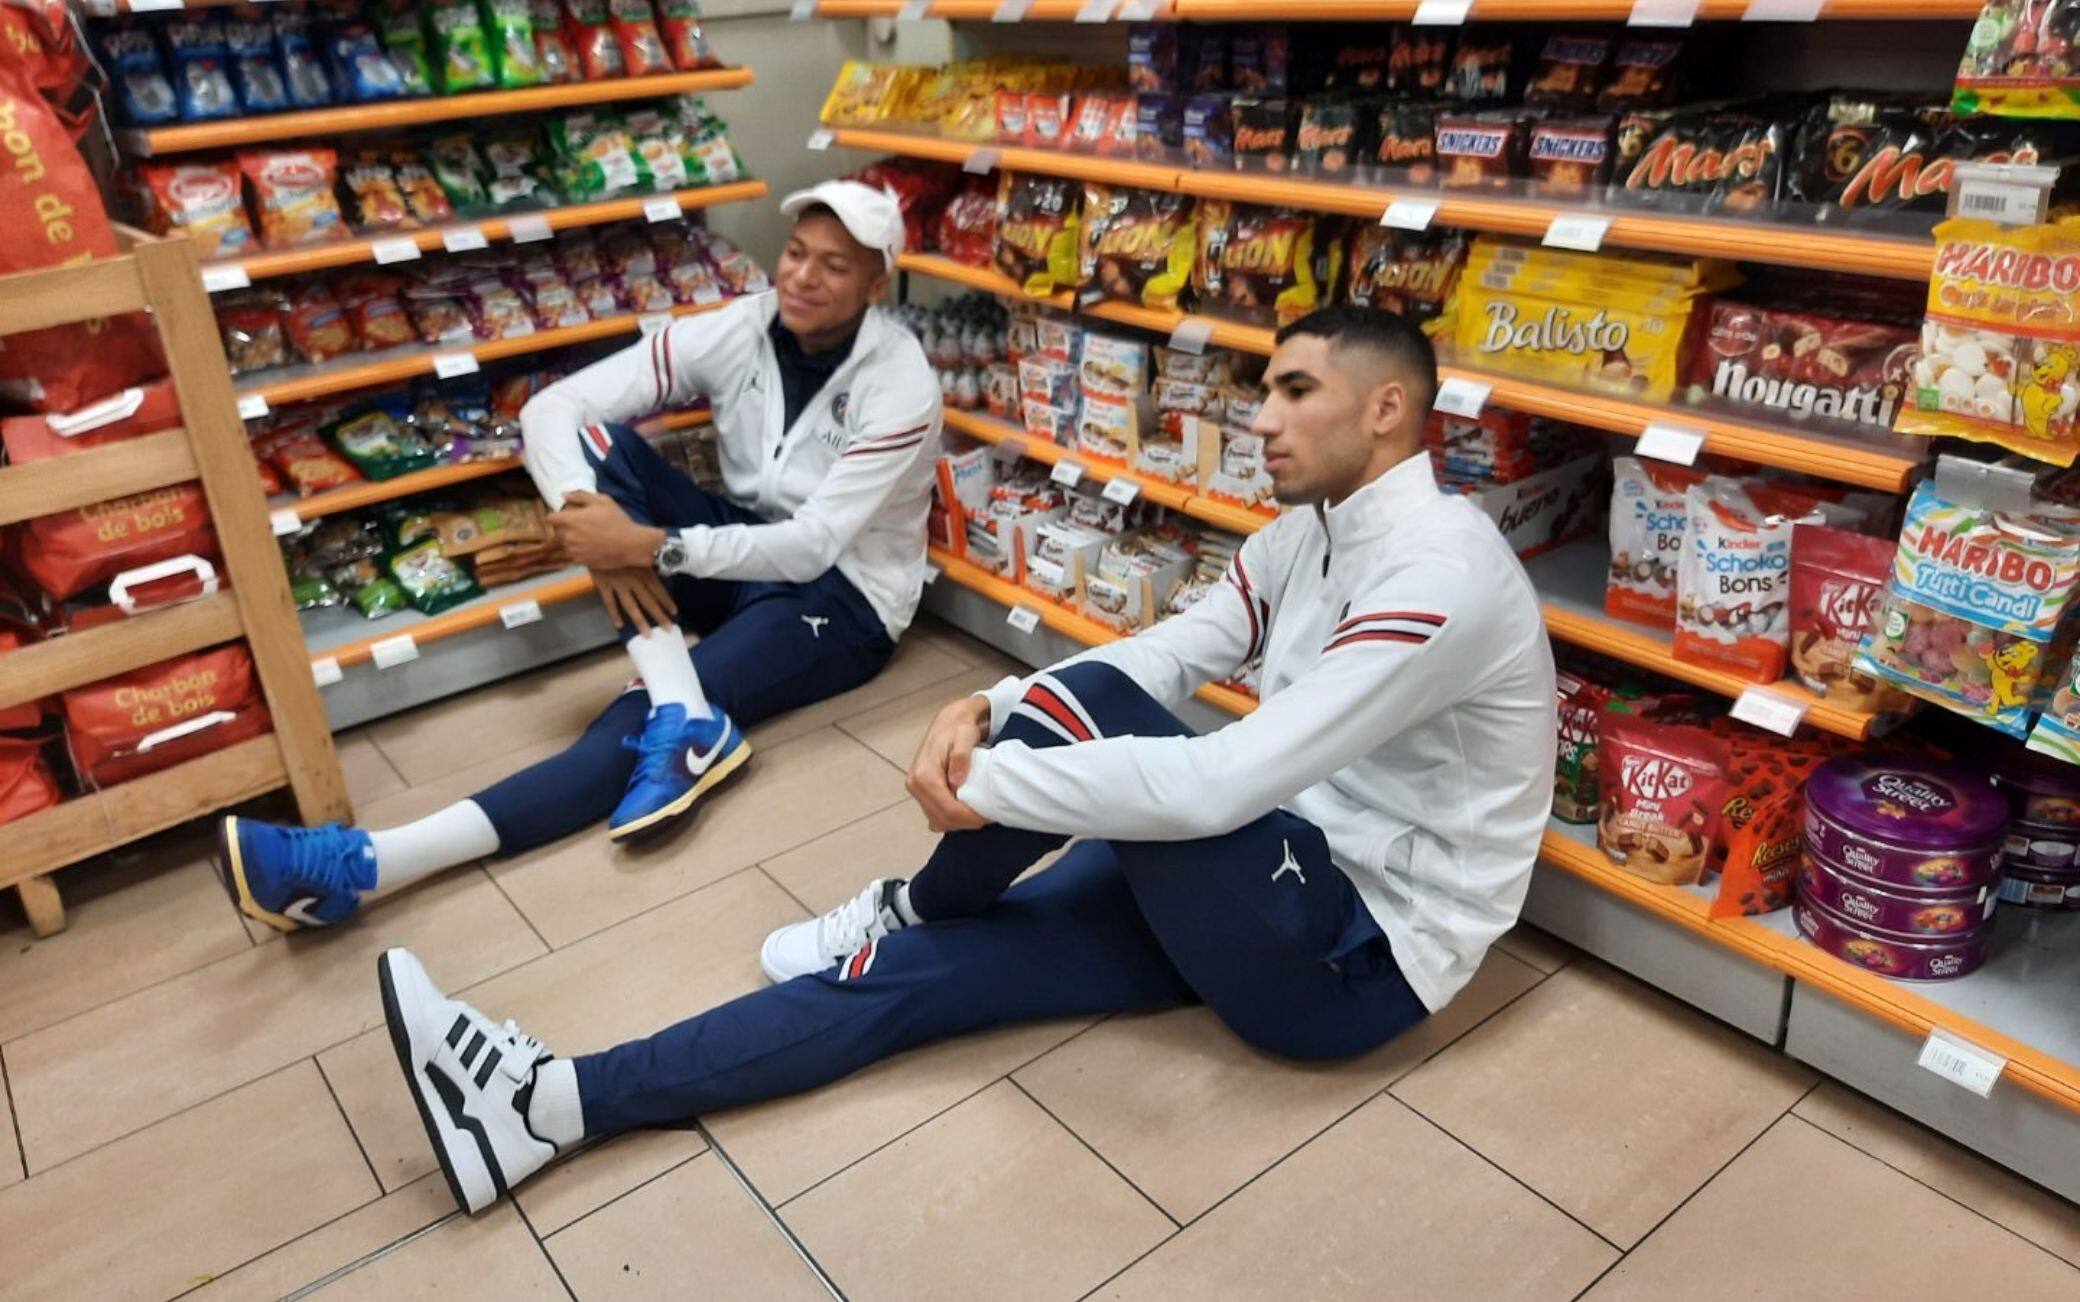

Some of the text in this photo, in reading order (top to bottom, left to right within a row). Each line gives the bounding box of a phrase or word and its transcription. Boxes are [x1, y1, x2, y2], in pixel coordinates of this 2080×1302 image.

[1440, 132, 1502, 151] SNICKERS
[1535, 136, 1608, 157] SNICKERS
[1626, 135, 1775, 190] Mars
[34, 194, 74, 244] de
[1935, 241, 2080, 294] HARIBO
[1480, 300, 1629, 355] Balisto
[97, 504, 184, 542] de bois
[1718, 536, 1762, 549] kinder
[1917, 525, 2053, 591] HARIBO
[1706, 552, 1787, 573] Schoko
[1719, 575, 1773, 594] Bons
[1917, 567, 1967, 598] Tutti
[115, 668, 217, 708] Charbon
[131, 692, 216, 726] de bois
[1627, 758, 1690, 799] KitKat
[1878, 775, 1952, 808] Quality
[1872, 780, 1931, 812] Street
[1842, 844, 1880, 867] Quality
[1845, 855, 1874, 874] Street
[1841, 892, 1880, 914] Quality
[1843, 903, 1875, 922] Street
[1929, 957, 1963, 970] Quality
